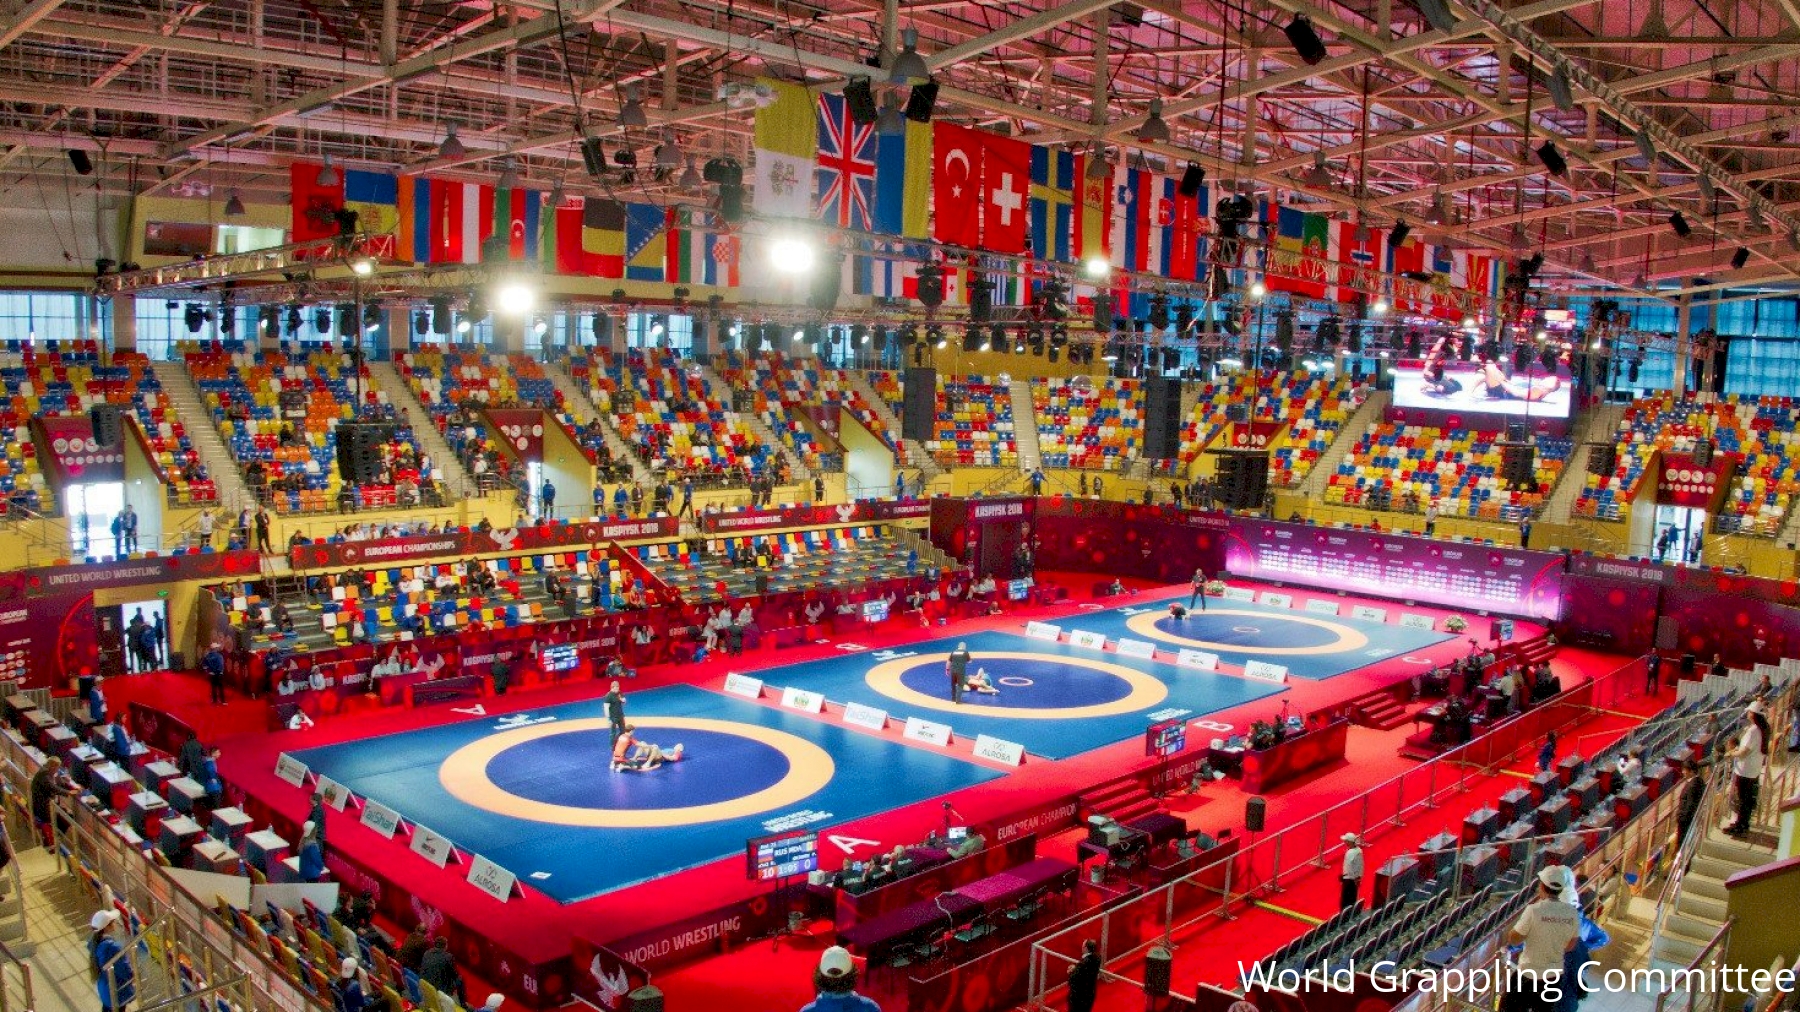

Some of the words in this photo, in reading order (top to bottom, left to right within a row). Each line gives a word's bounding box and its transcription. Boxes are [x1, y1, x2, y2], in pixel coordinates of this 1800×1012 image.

[603, 525, 640, 537] KASPIYSK
[642, 523, 659, 534] 2018
[365, 544, 402, 556] EUROPEAN
[403, 540, 455, 553] CHAMPIONSHIPS
[49, 573, 80, 585] UNITED
[80, 570, 112, 582] WORLD
[113, 566, 161, 578] WRESTLING
[1596, 562, 1639, 577] KASPIYSK
[1641, 568, 1664, 580] 2018
[1192, 720, 1235, 732] B
[827, 834, 882, 855] A
[762, 867, 774, 878] 10
[804, 859, 811, 870] 0
[624, 939, 670, 965] WORLD
[672, 916, 741, 951] WRESTLING
